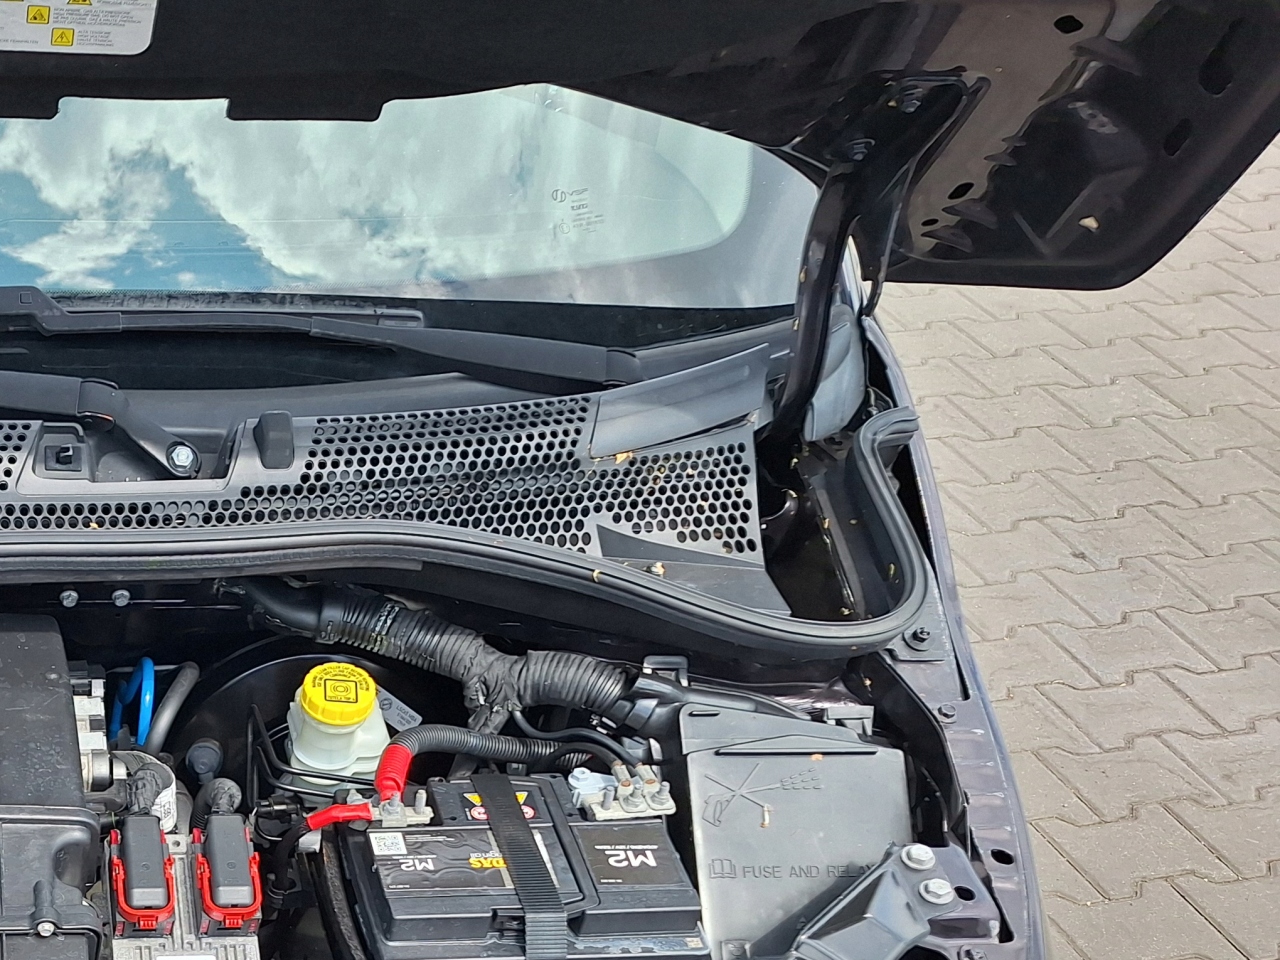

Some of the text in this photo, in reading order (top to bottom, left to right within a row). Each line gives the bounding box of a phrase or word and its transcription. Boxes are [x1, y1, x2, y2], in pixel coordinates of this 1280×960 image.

[399, 858, 435, 871] M2
[604, 850, 657, 867] M2
[742, 865, 782, 879] FUSE
[789, 865, 820, 878] AND
